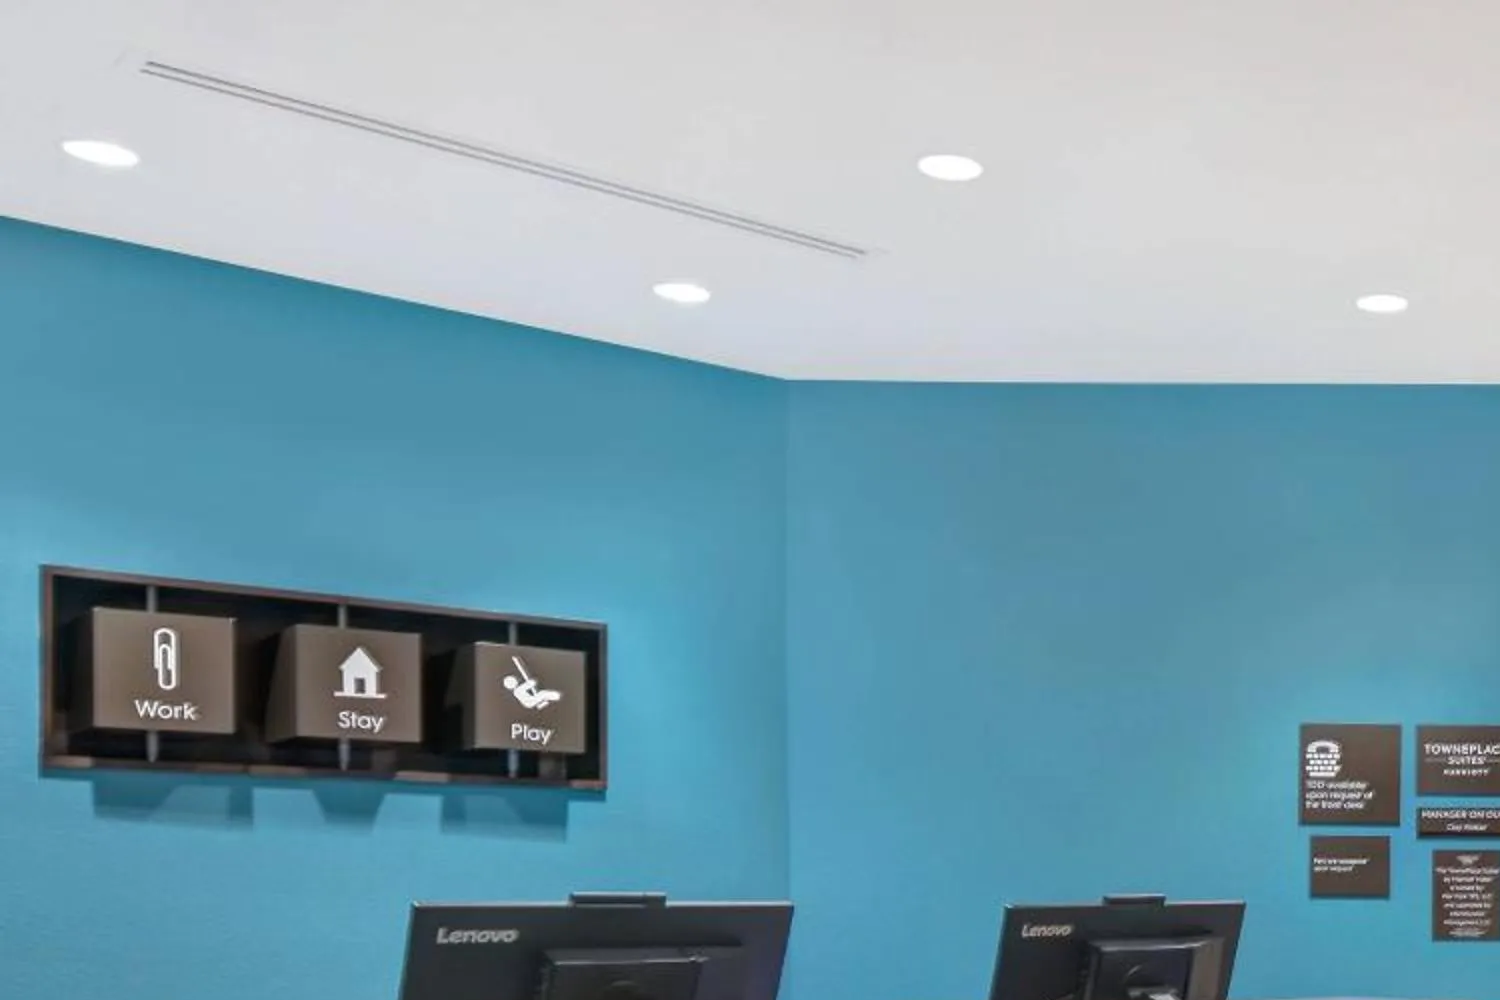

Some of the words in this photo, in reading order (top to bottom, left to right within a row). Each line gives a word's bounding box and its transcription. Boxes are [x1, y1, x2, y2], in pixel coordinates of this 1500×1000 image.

[134, 699, 197, 721] Work
[338, 710, 385, 733] Stay
[511, 722, 552, 746] Play
[1329, 791, 1363, 801] request
[1305, 800, 1321, 809] the
[1421, 809, 1468, 819] MANAGER
[1468, 809, 1485, 819] ON
[436, 927, 520, 945] Lenovo
[1021, 924, 1074, 938] Lenovo
